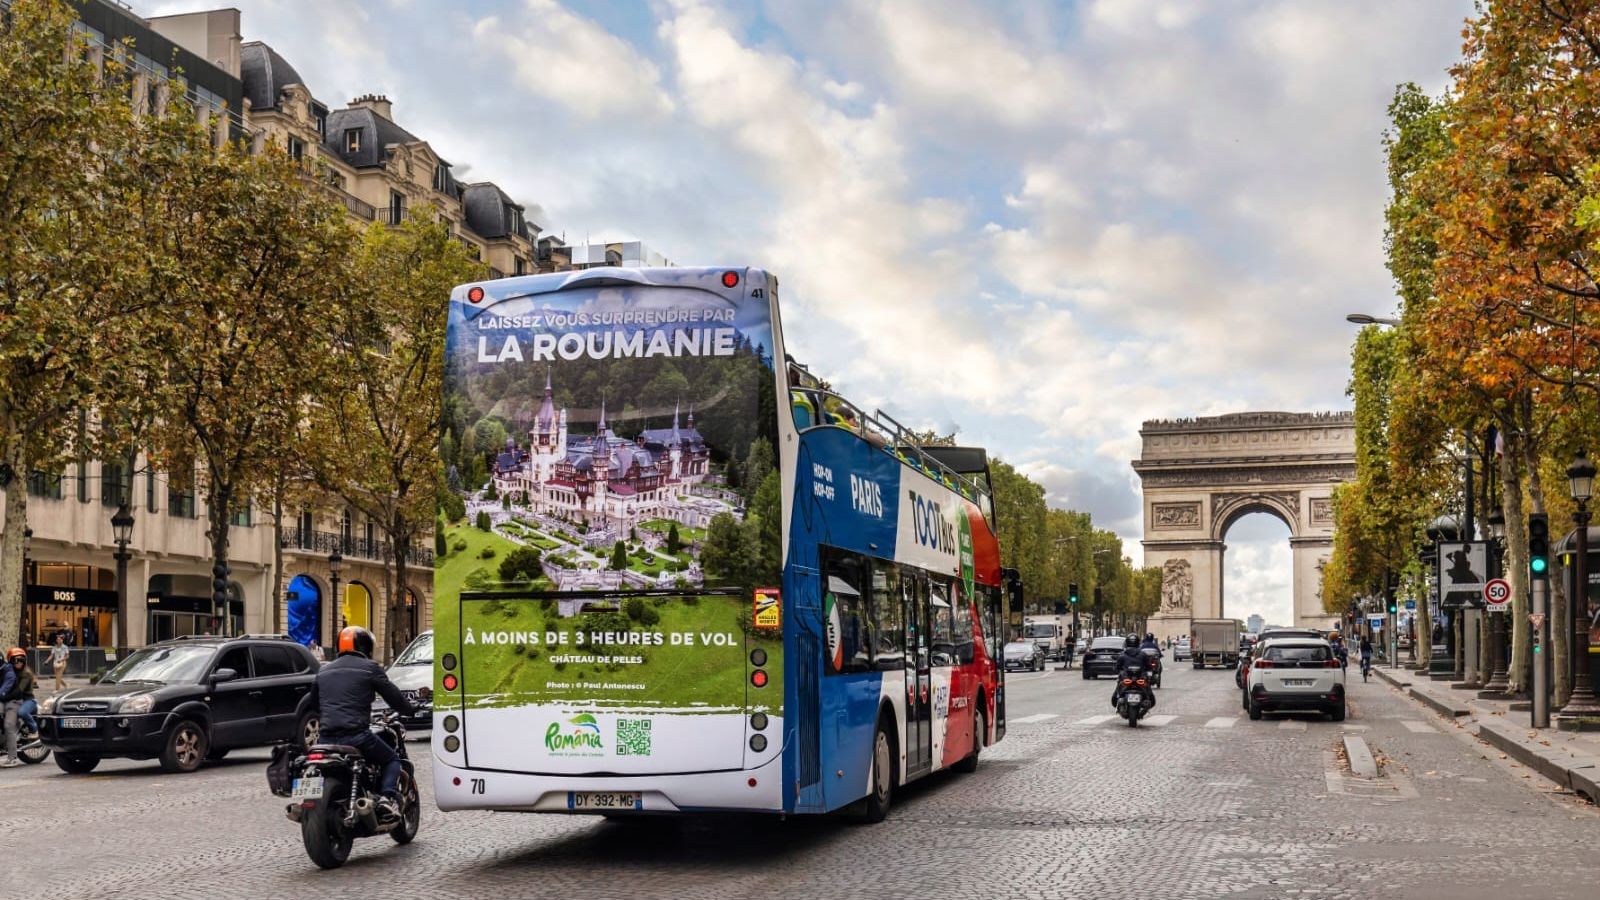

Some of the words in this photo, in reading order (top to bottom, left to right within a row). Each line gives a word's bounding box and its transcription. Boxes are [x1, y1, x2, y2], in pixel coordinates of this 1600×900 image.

[751, 288, 763, 299] 41
[478, 315, 541, 330] LAISSEZ
[544, 313, 588, 328] VOUS
[592, 309, 698, 325] SURPRENDRE
[703, 308, 735, 322] PAR
[477, 335, 524, 363] LA
[533, 327, 736, 362] ROUMANIE
[813, 462, 833, 483] HOP-ON
[813, 481, 835, 502] HOP-OFF
[850, 473, 883, 519] PARIS
[53, 591, 76, 602] BOSS
[1490, 587, 1506, 597] 50
[464, 627, 476, 645] À
[481, 631, 540, 645] MOINS
[545, 631, 569, 645] DE
[575, 631, 585, 645] 3
[591, 631, 664, 646] HEURES
[670, 632, 695, 646] DE
[700, 632, 738, 647] VOL
[549, 653, 595, 664] CHÂTEAU
[597, 655, 611, 664] DE
[613, 655, 643, 664] PELES
[546, 682, 570, 690] Photo
[583, 682, 601, 690] Paul
[602, 682, 646, 690] Antonescu
[545, 721, 603, 752] România
[470, 778, 486, 795] 70
[575, 794, 634, 807] DY-392-MG
